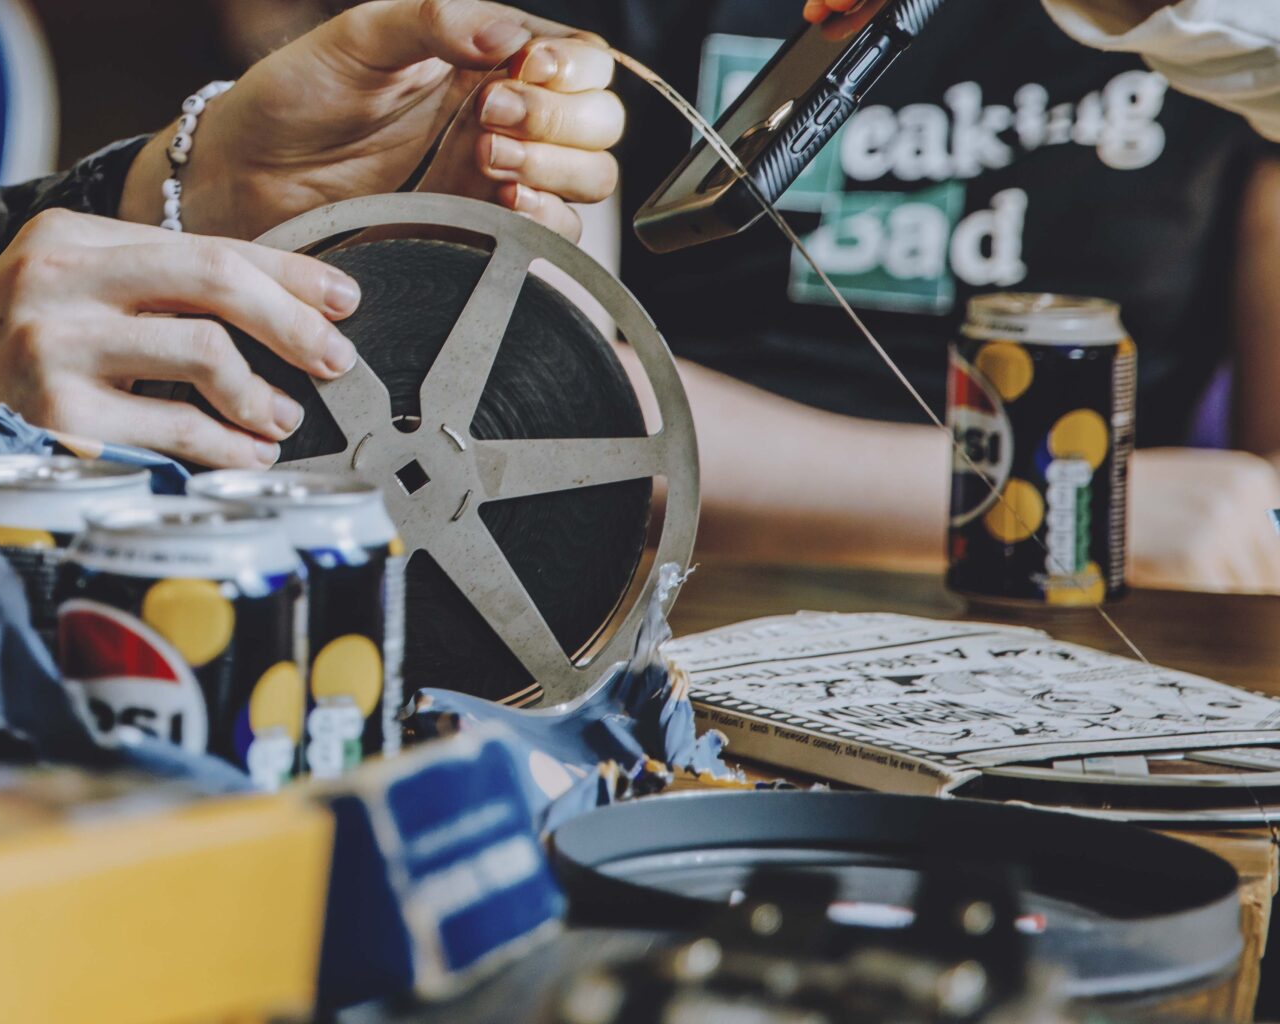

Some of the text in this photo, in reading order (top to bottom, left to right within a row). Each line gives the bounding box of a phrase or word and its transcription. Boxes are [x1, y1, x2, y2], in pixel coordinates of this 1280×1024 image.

[750, 722, 769, 734] tenth
[774, 726, 810, 744] Pinewood
[845, 745, 857, 757] the
[858, 747, 888, 766] funniest
[889, 755, 899, 768] he
[900, 761, 916, 772] ever
